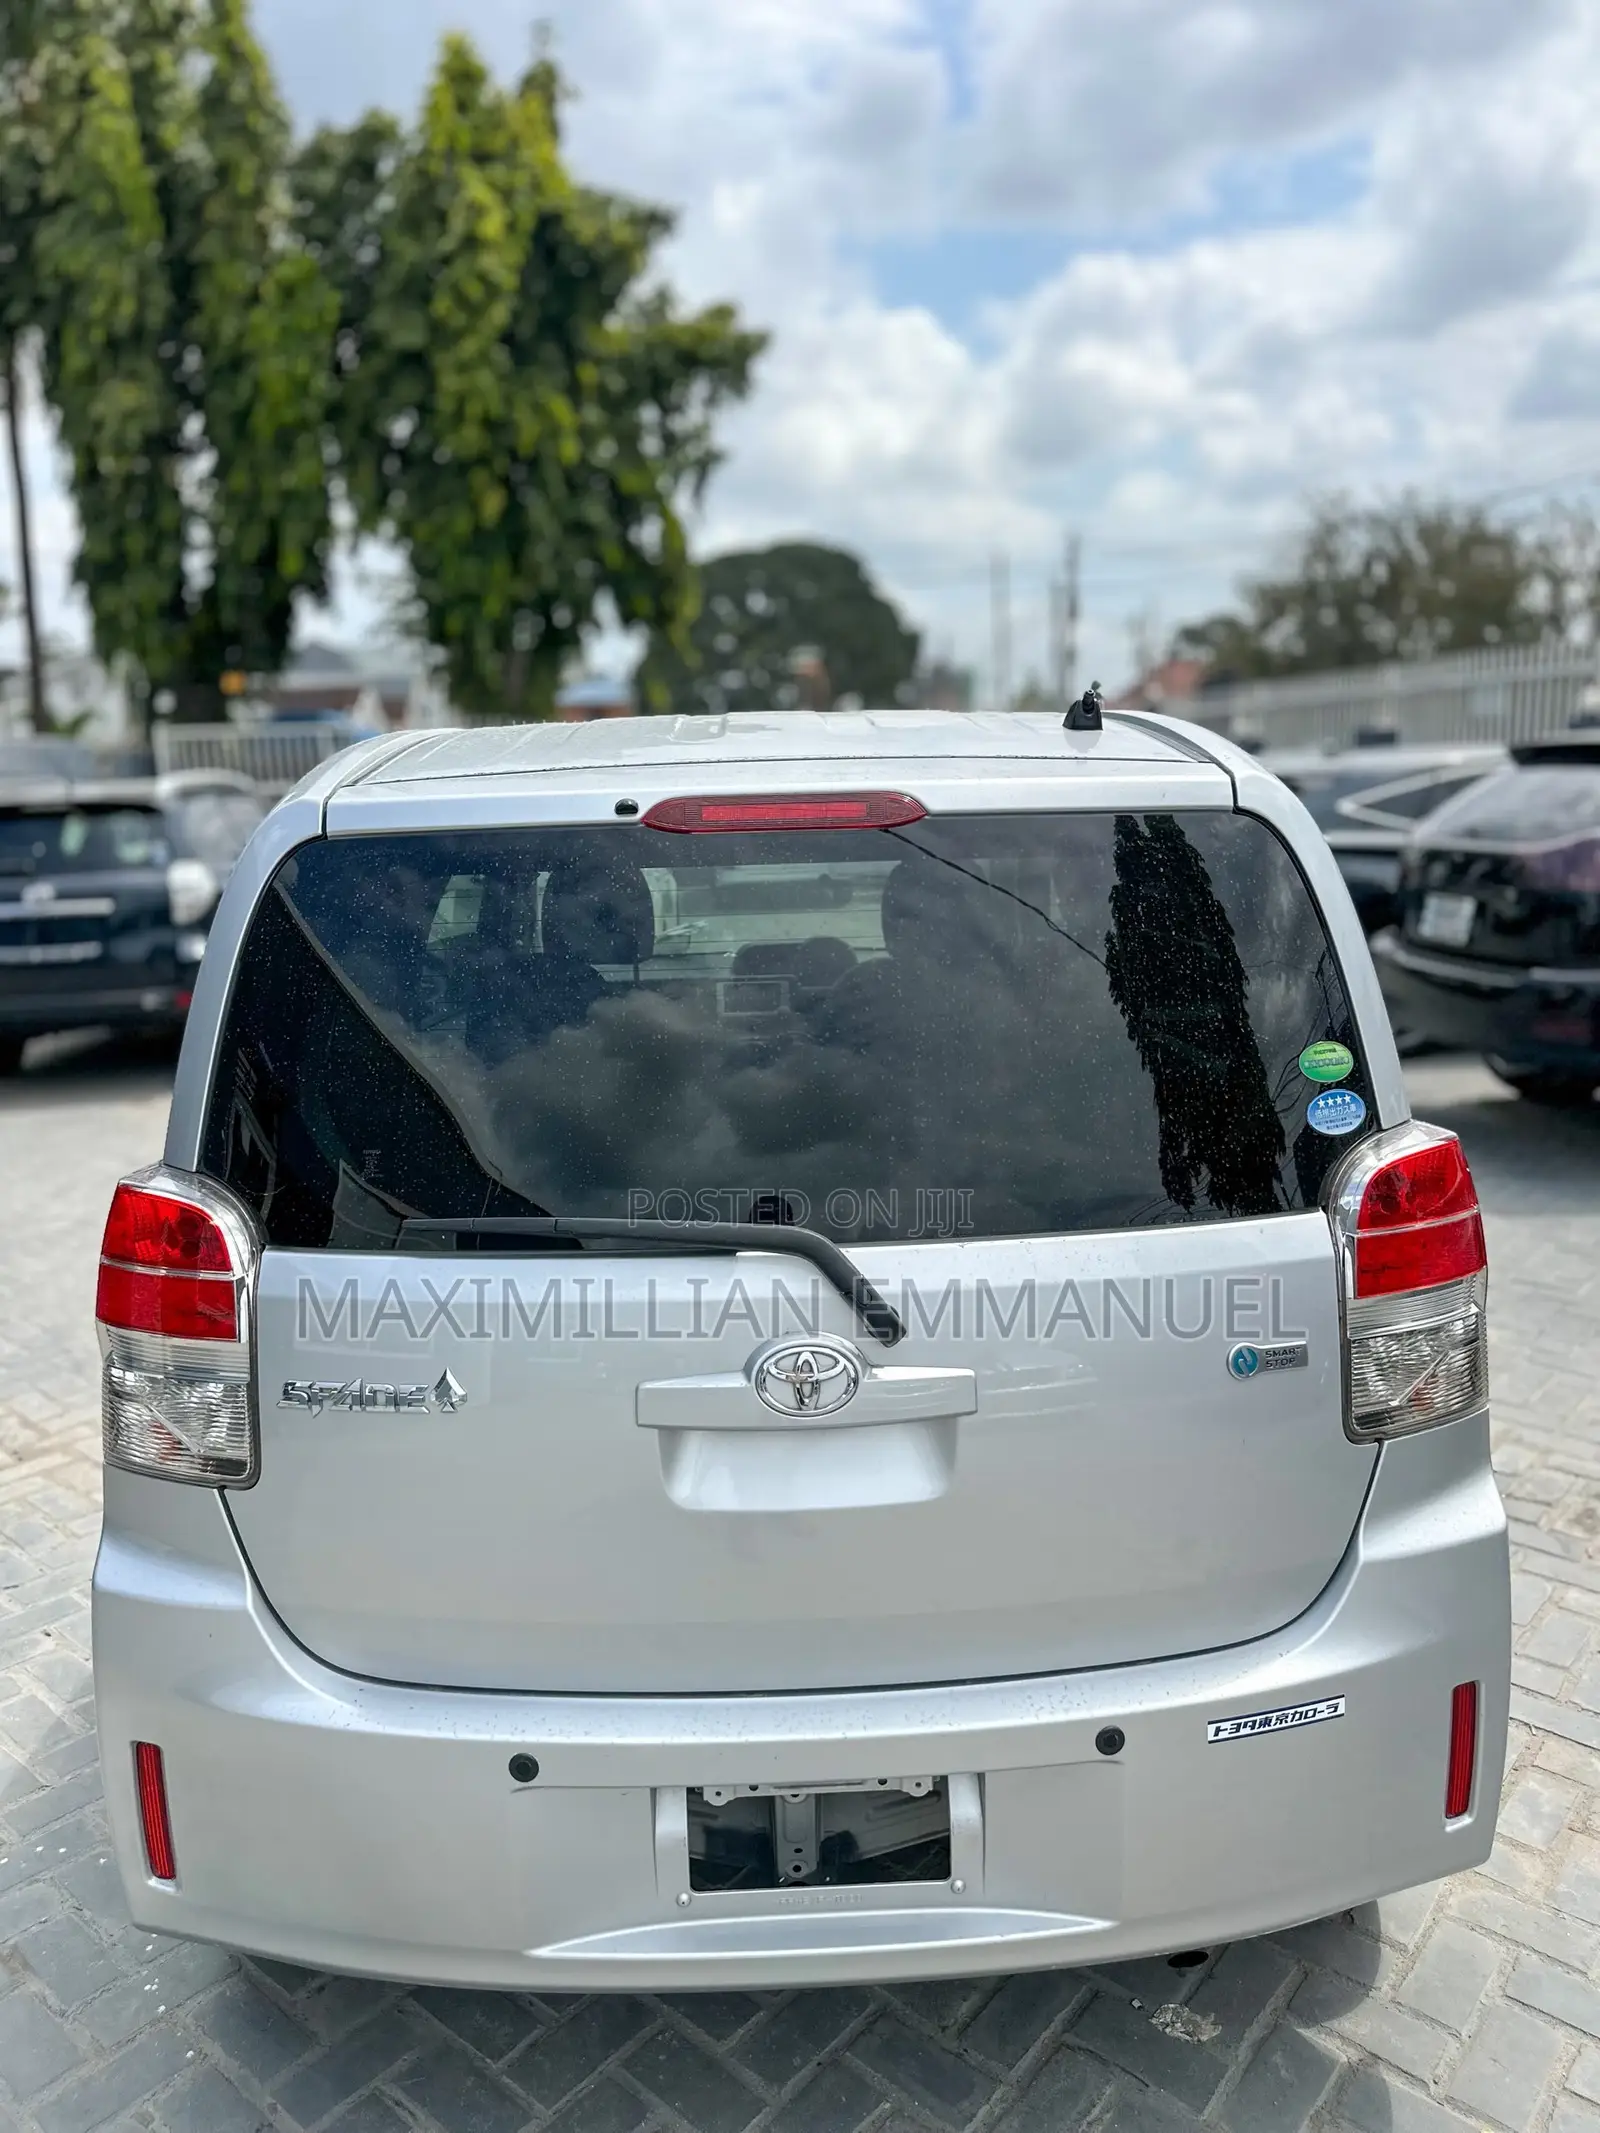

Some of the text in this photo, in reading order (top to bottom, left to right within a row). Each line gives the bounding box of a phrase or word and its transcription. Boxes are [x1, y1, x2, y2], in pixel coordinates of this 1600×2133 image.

[1265, 1347, 1302, 1357] SMART
[1265, 1357, 1296, 1368] STOP
[276, 1377, 431, 1419] SPADE
[1213, 1702, 1340, 1737] トヨタ東京カローラ
